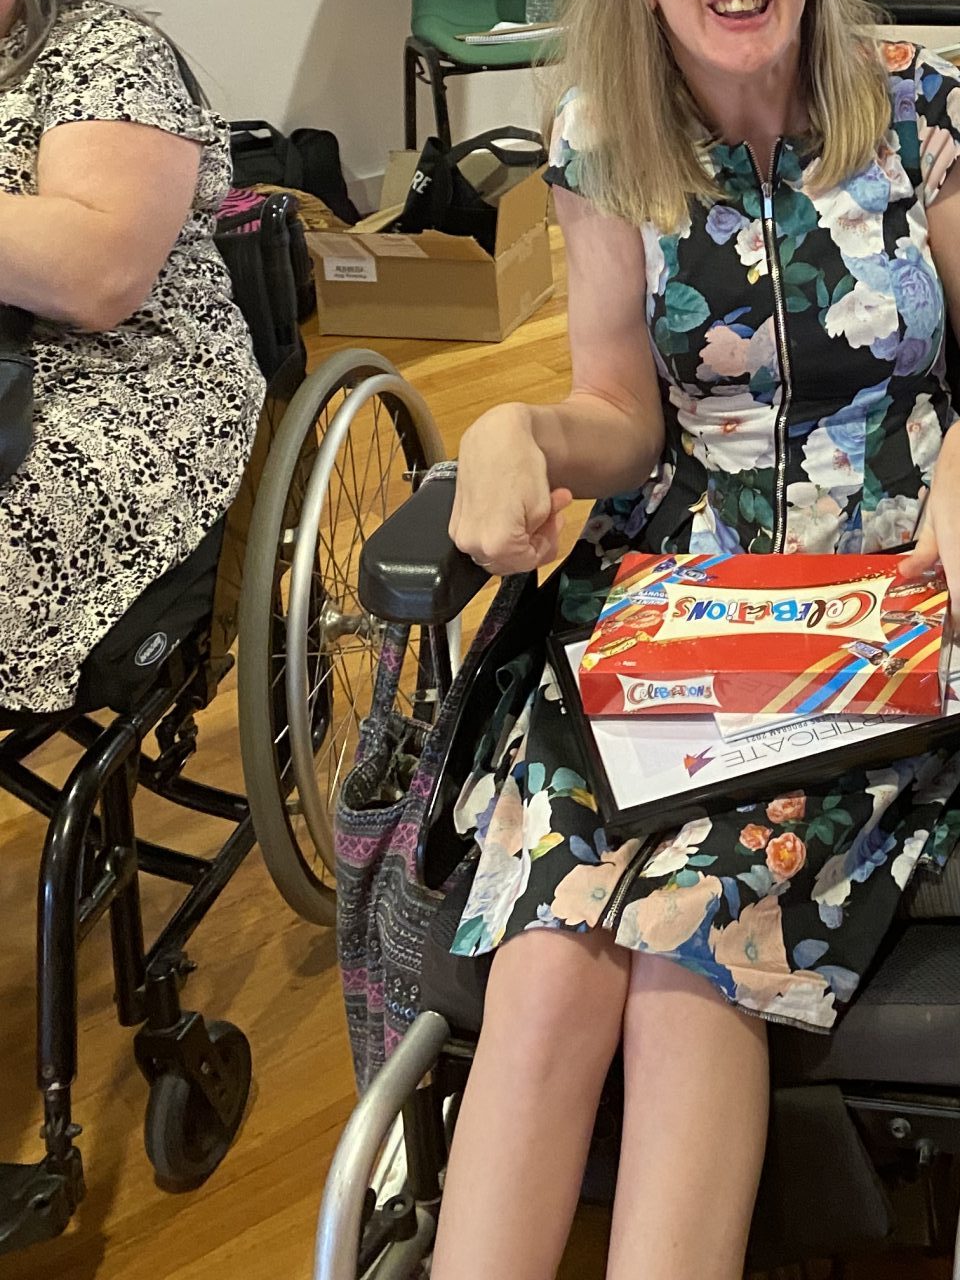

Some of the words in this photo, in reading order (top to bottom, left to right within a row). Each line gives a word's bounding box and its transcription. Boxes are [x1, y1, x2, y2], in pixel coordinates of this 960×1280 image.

[745, 731, 769, 742] 2021
[769, 718, 808, 737] PROGRAM
[721, 715, 906, 768] RTIFICATE
